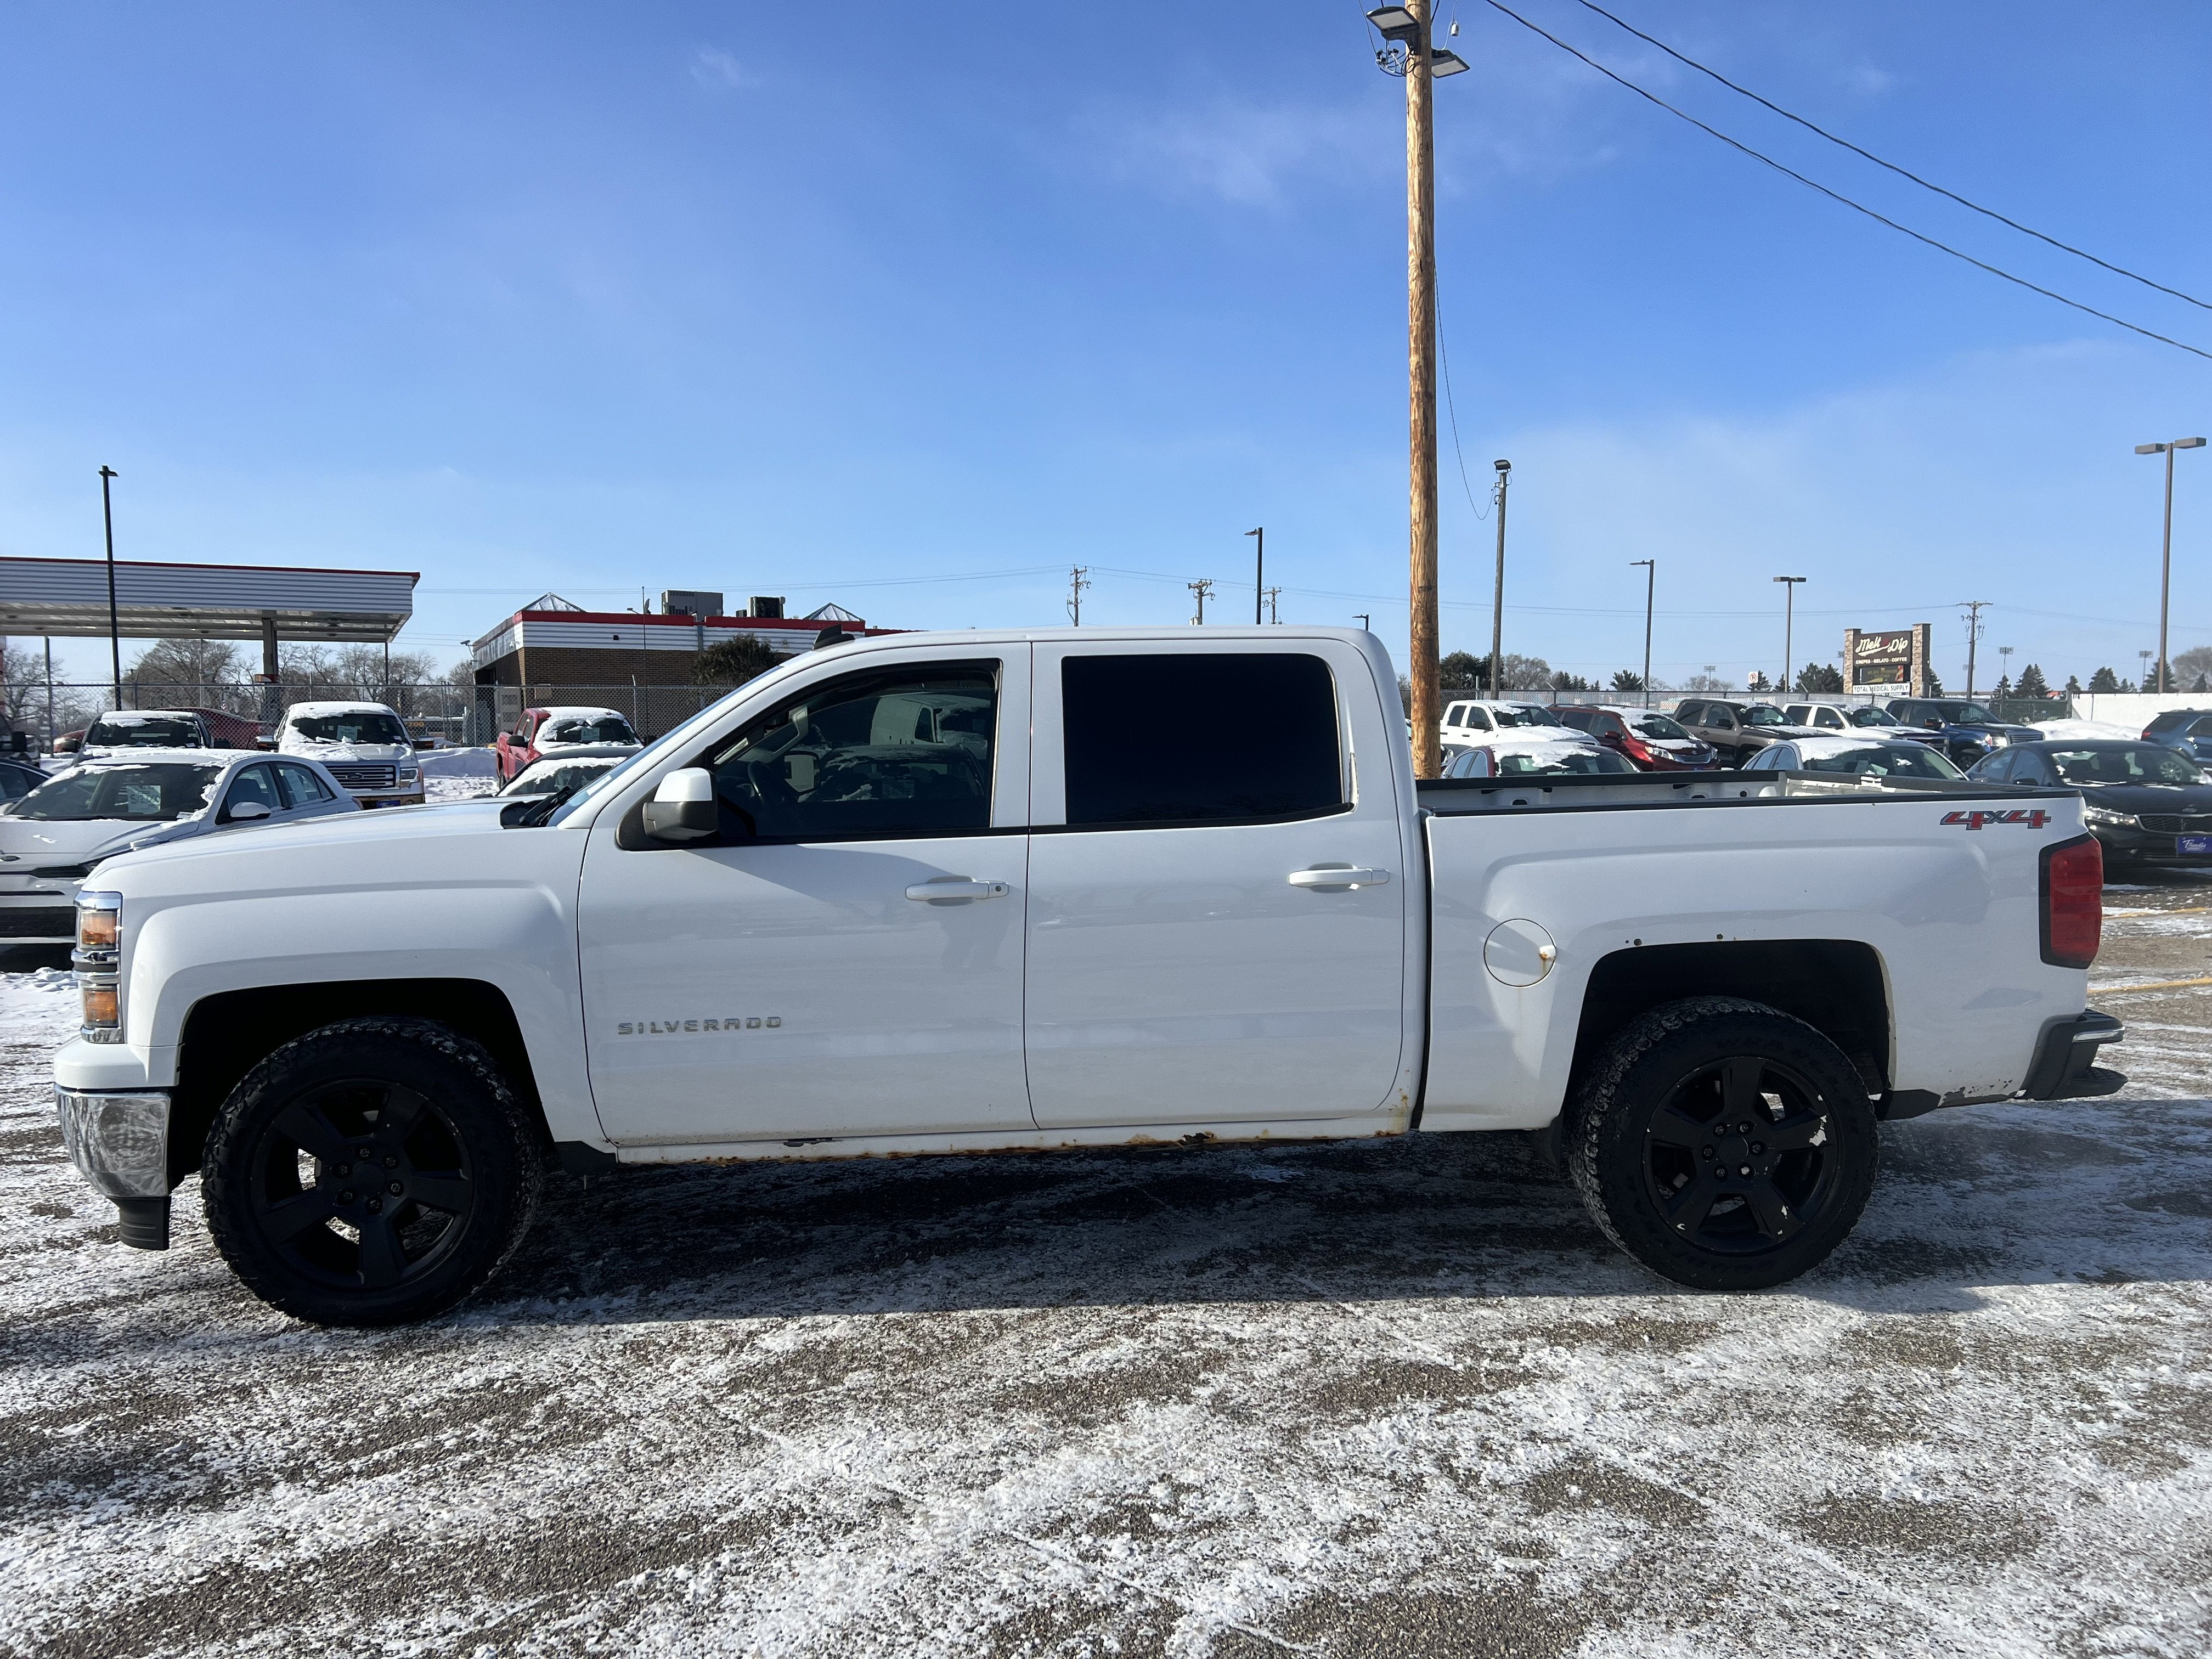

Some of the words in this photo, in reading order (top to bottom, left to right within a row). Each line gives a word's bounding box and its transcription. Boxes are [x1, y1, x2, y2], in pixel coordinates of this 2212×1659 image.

[1855, 636, 1881, 653] Melt
[1887, 637, 1908, 653] Dip
[618, 1017, 781, 1035] SILVERADO
